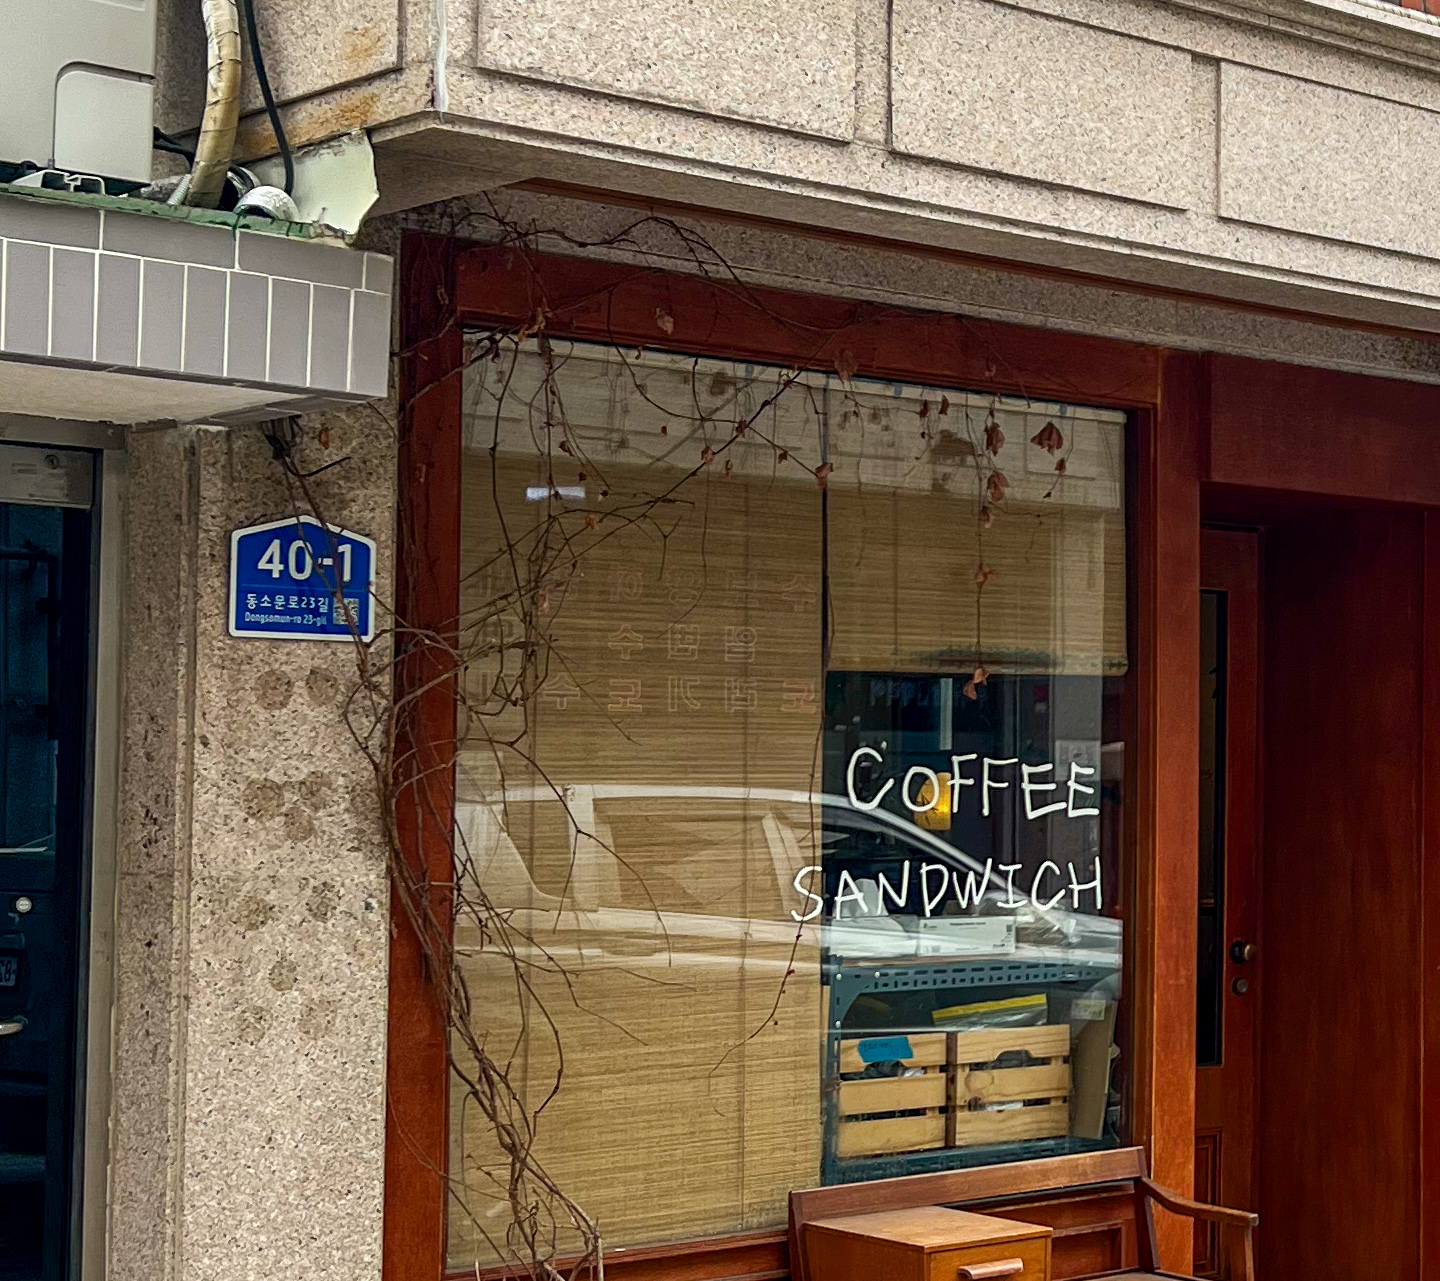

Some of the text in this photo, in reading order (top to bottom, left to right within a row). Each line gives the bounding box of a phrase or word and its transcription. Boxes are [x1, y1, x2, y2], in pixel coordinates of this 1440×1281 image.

[257, 538, 353, 584] 40-1
[847, 747, 1100, 820] COFFEE
[790, 856, 1103, 922] SANDWICH
